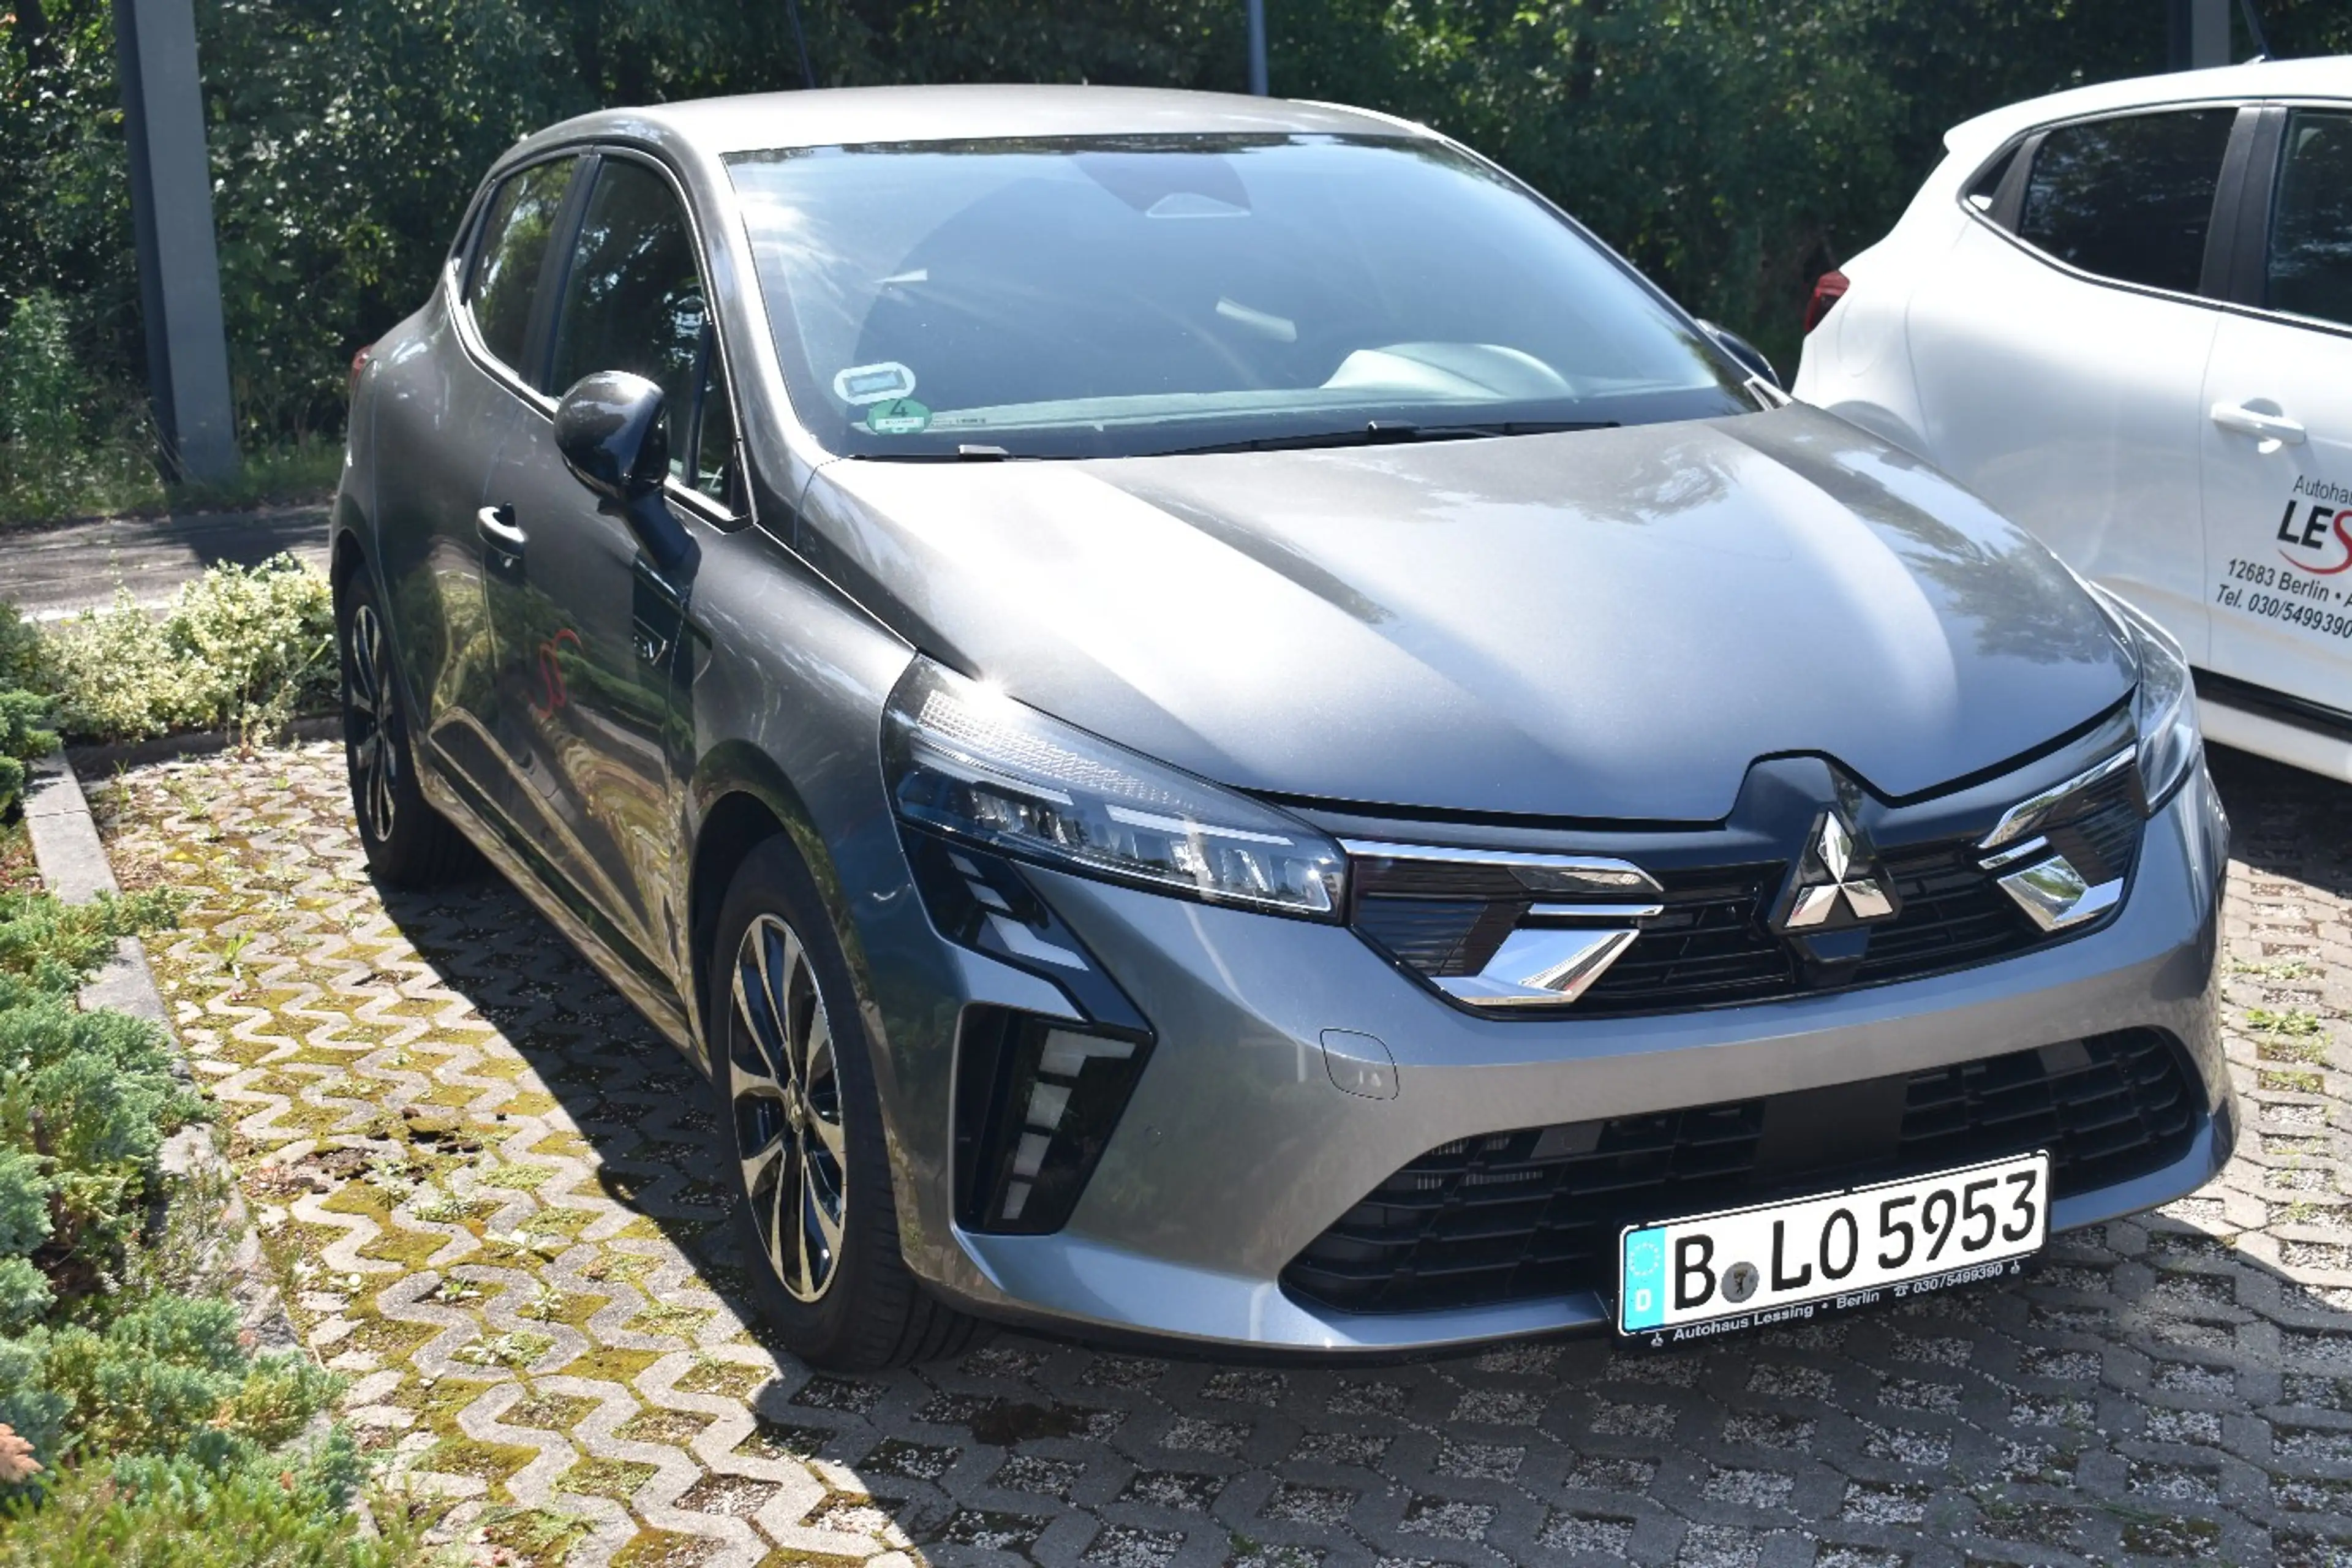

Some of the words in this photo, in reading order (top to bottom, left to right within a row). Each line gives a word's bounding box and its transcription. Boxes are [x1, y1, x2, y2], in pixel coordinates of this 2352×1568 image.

[890, 399, 909, 417] 4
[2229, 558, 2275, 587] 12683
[2278, 571, 2330, 602] Berlin
[2216, 584, 2242, 608] Tel.
[2248, 593, 2352, 638] 030/5499390
[1674, 1234, 1717, 1310] B
[1771, 1208, 1858, 1292] LO
[1878, 1169, 2037, 1270] 5953
[1635, 1288, 1651, 1311] D
[1673, 1317, 1749, 1342] Autohaus
[1754, 1304, 1814, 1326] Lessing
[1836, 1289, 1879, 1310] Berlin
[1913, 1263, 2003, 1294] 030/5499390
